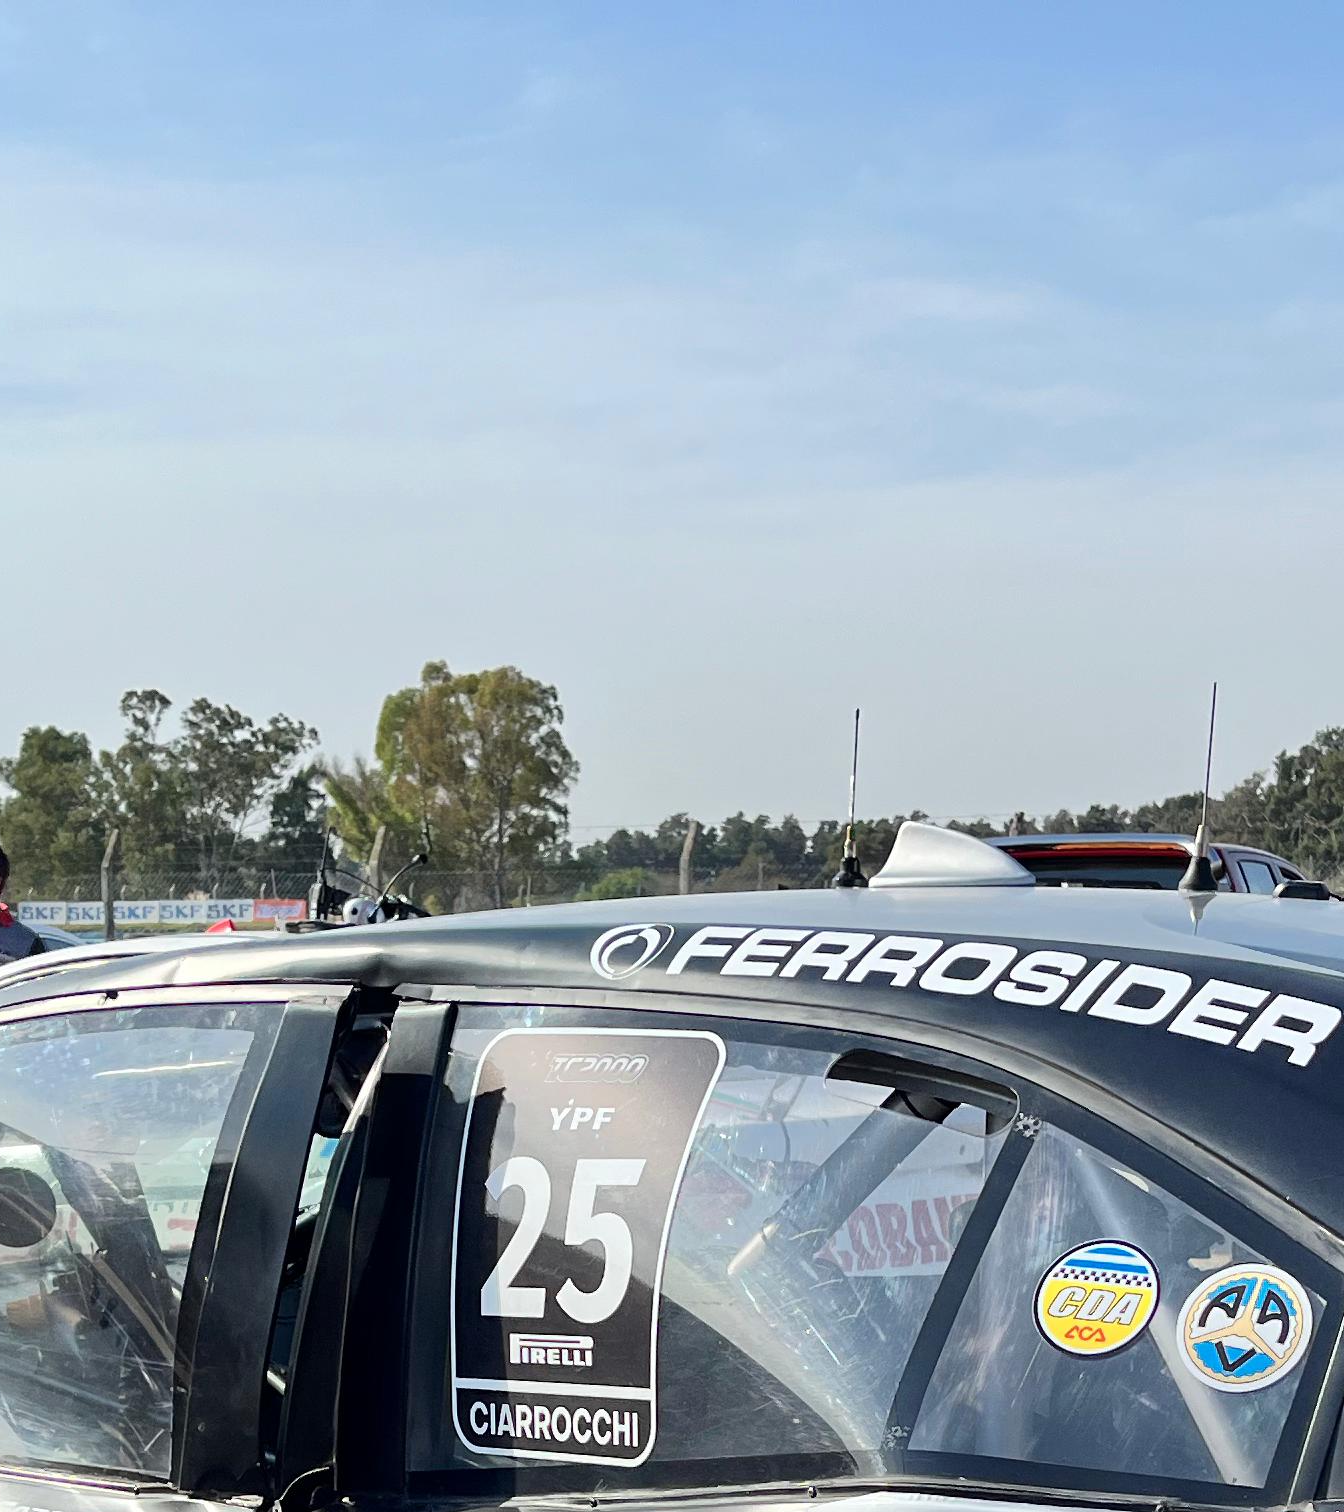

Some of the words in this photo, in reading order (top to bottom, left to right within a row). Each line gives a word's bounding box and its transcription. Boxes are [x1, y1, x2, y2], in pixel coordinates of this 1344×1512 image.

[21, 902, 63, 920] SKF
[113, 903, 157, 920] SKF
[159, 902, 204, 919] SKF
[206, 902, 253, 919] SKF
[667, 925, 1342, 1067] FERROSIDER
[549, 1106, 616, 1131] YPF
[480, 1156, 646, 1325] 25
[1047, 1285, 1144, 1326] CDA
[509, 1332, 594, 1367] PIRELLI
[469, 1400, 640, 1448] CIARROCCHI
